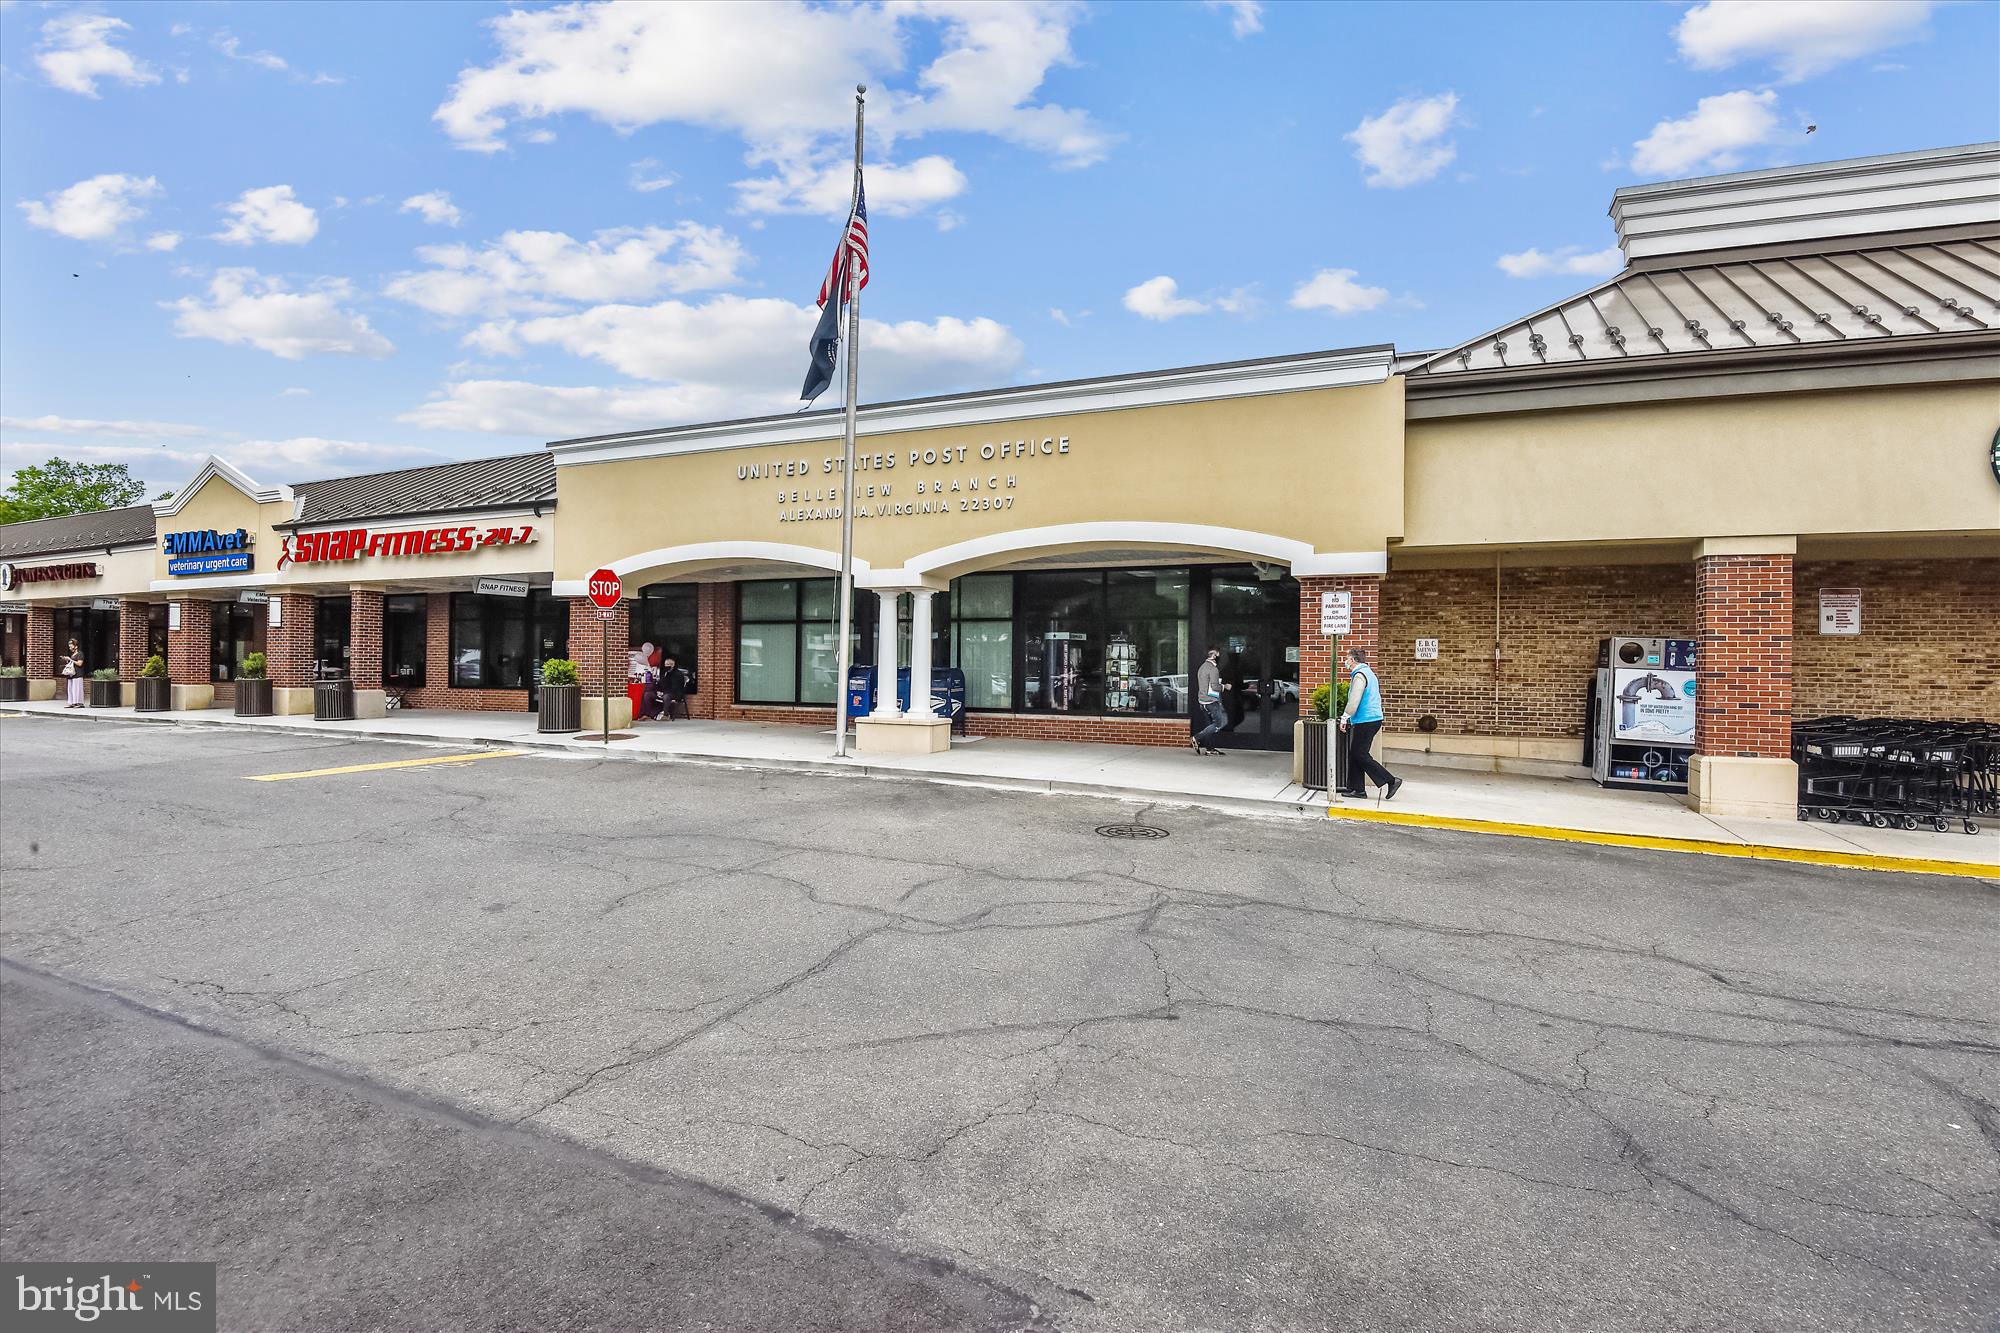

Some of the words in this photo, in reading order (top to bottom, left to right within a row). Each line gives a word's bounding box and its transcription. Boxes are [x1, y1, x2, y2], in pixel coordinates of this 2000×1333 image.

[737, 462, 809, 480] UNITED
[908, 445, 967, 466] POST
[980, 436, 1070, 460] OFFICE
[778, 484, 893, 503] BELLEIEW
[917, 475, 1018, 494] BRANCH
[960, 496, 1015, 511] 22307
[163, 528, 246, 554] EMMAvet
[367, 527, 476, 556] FITNESS
[169, 560, 204, 572] veterinary
[205, 557, 229, 571] urgent
[231, 557, 247, 567] care
[480, 583, 499, 591] SNAP
[500, 584, 526, 593] FITNESS
[590, 581, 619, 596] STOP
